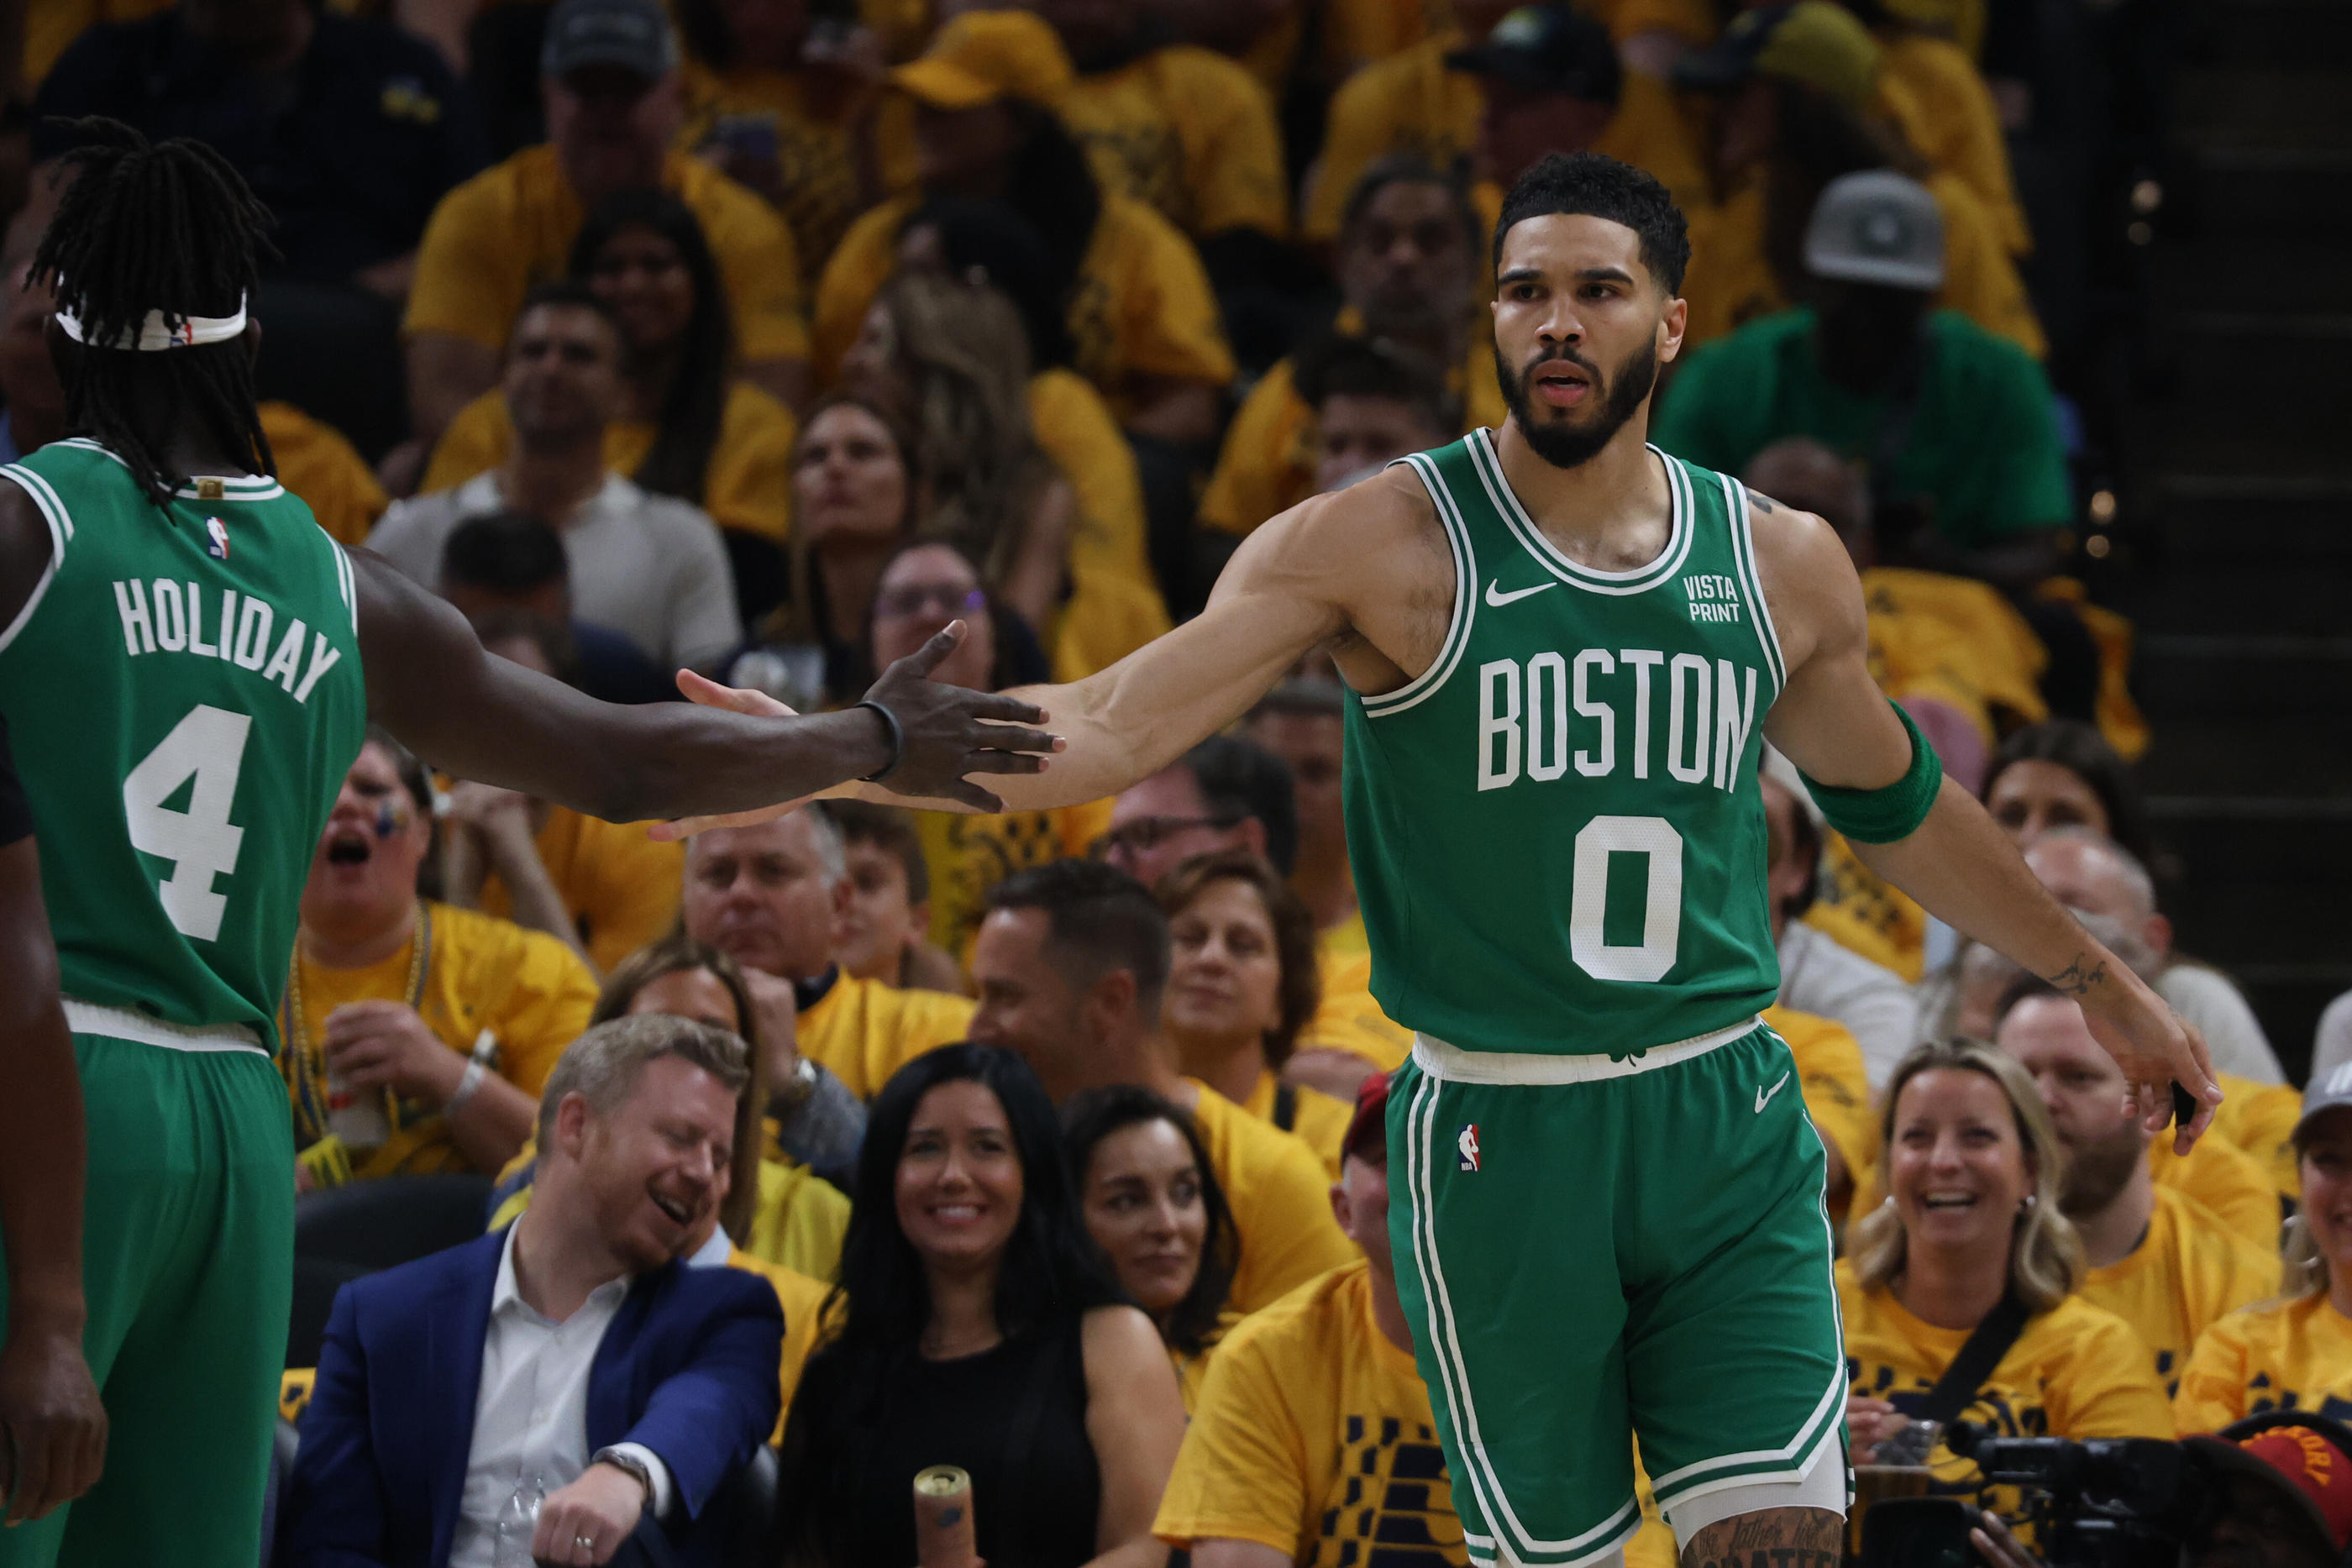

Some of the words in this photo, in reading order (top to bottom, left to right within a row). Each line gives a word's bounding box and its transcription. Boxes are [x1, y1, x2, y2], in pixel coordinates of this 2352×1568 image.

[113, 577, 342, 704] HOLIDAY
[1683, 574, 1739, 602] VISTA
[1688, 602, 1740, 622] PRINT
[1478, 648, 1756, 793] BOSTON
[123, 704, 252, 942] 4
[1570, 815, 1683, 982] 0
[1461, 1162, 1473, 1171] NBA
